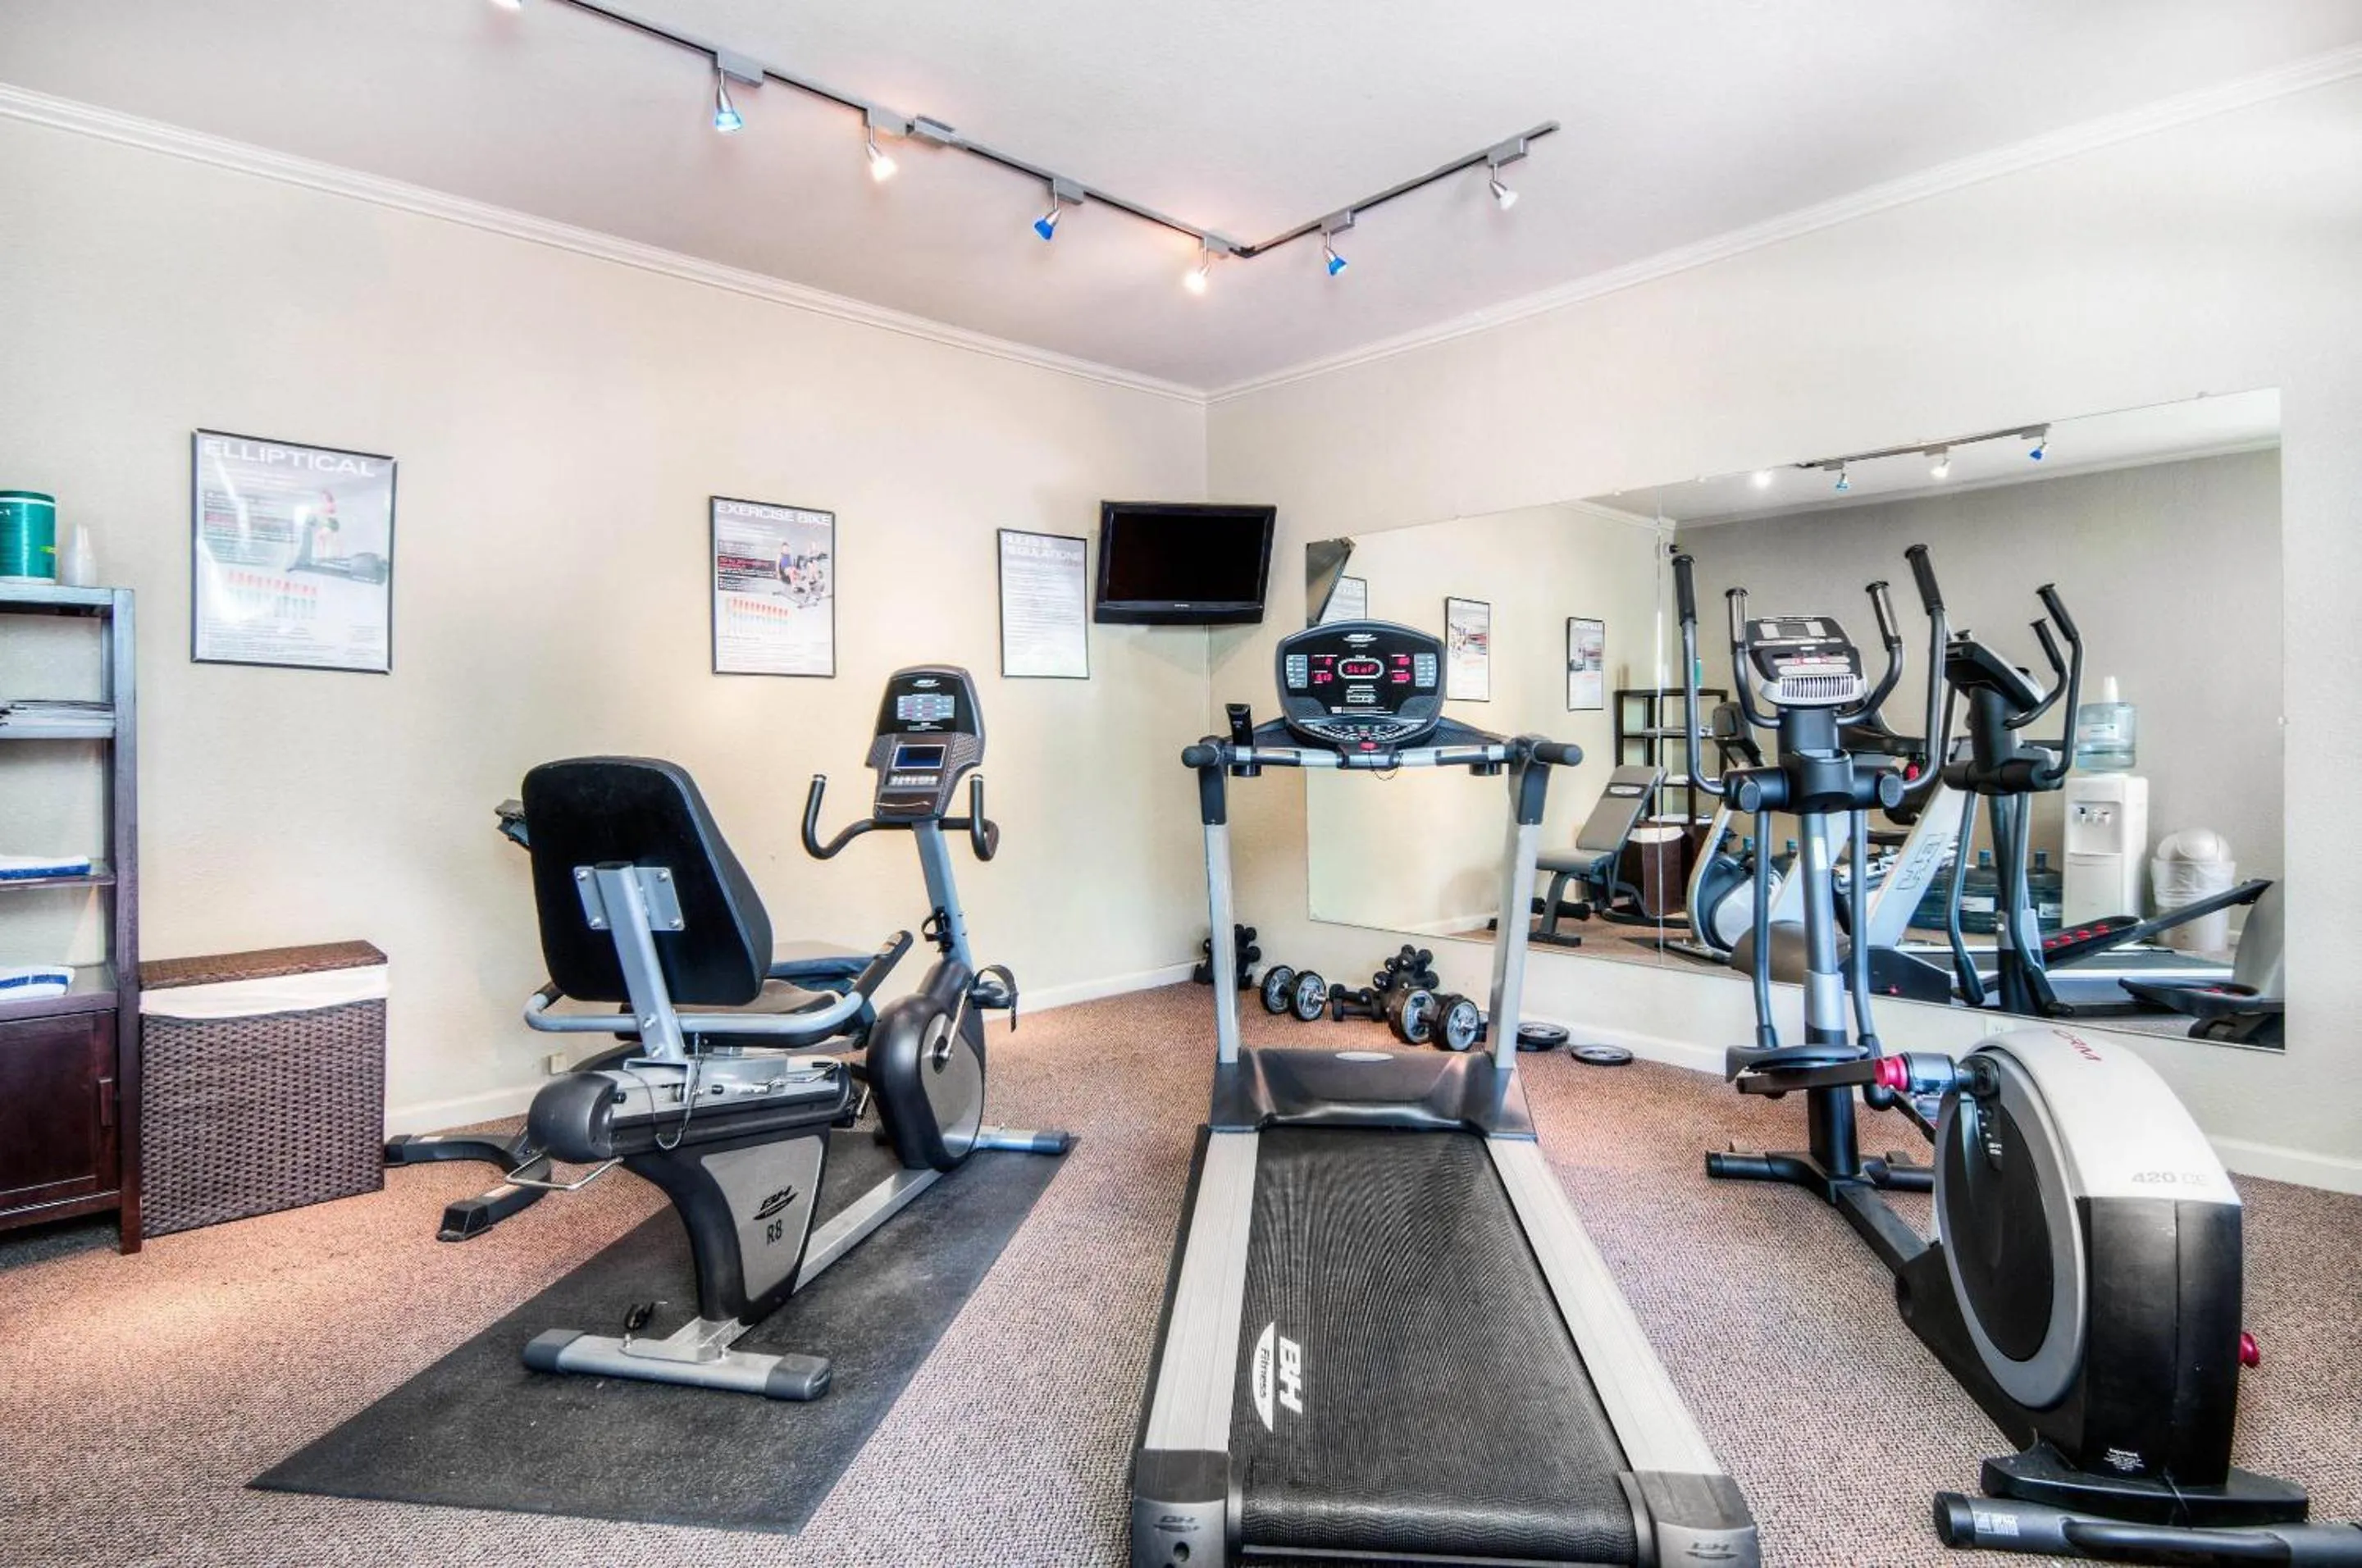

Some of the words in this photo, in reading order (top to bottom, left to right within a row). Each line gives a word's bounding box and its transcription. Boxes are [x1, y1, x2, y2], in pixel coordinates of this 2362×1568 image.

[203, 439, 376, 478] ELLIPTICAL
[717, 501, 795, 522] EXERCISE
[797, 512, 832, 526] BIKE
[2132, 1171, 2177, 1183] 420
[766, 1218, 783, 1245] R8
[1279, 1336, 1303, 1414] BH
